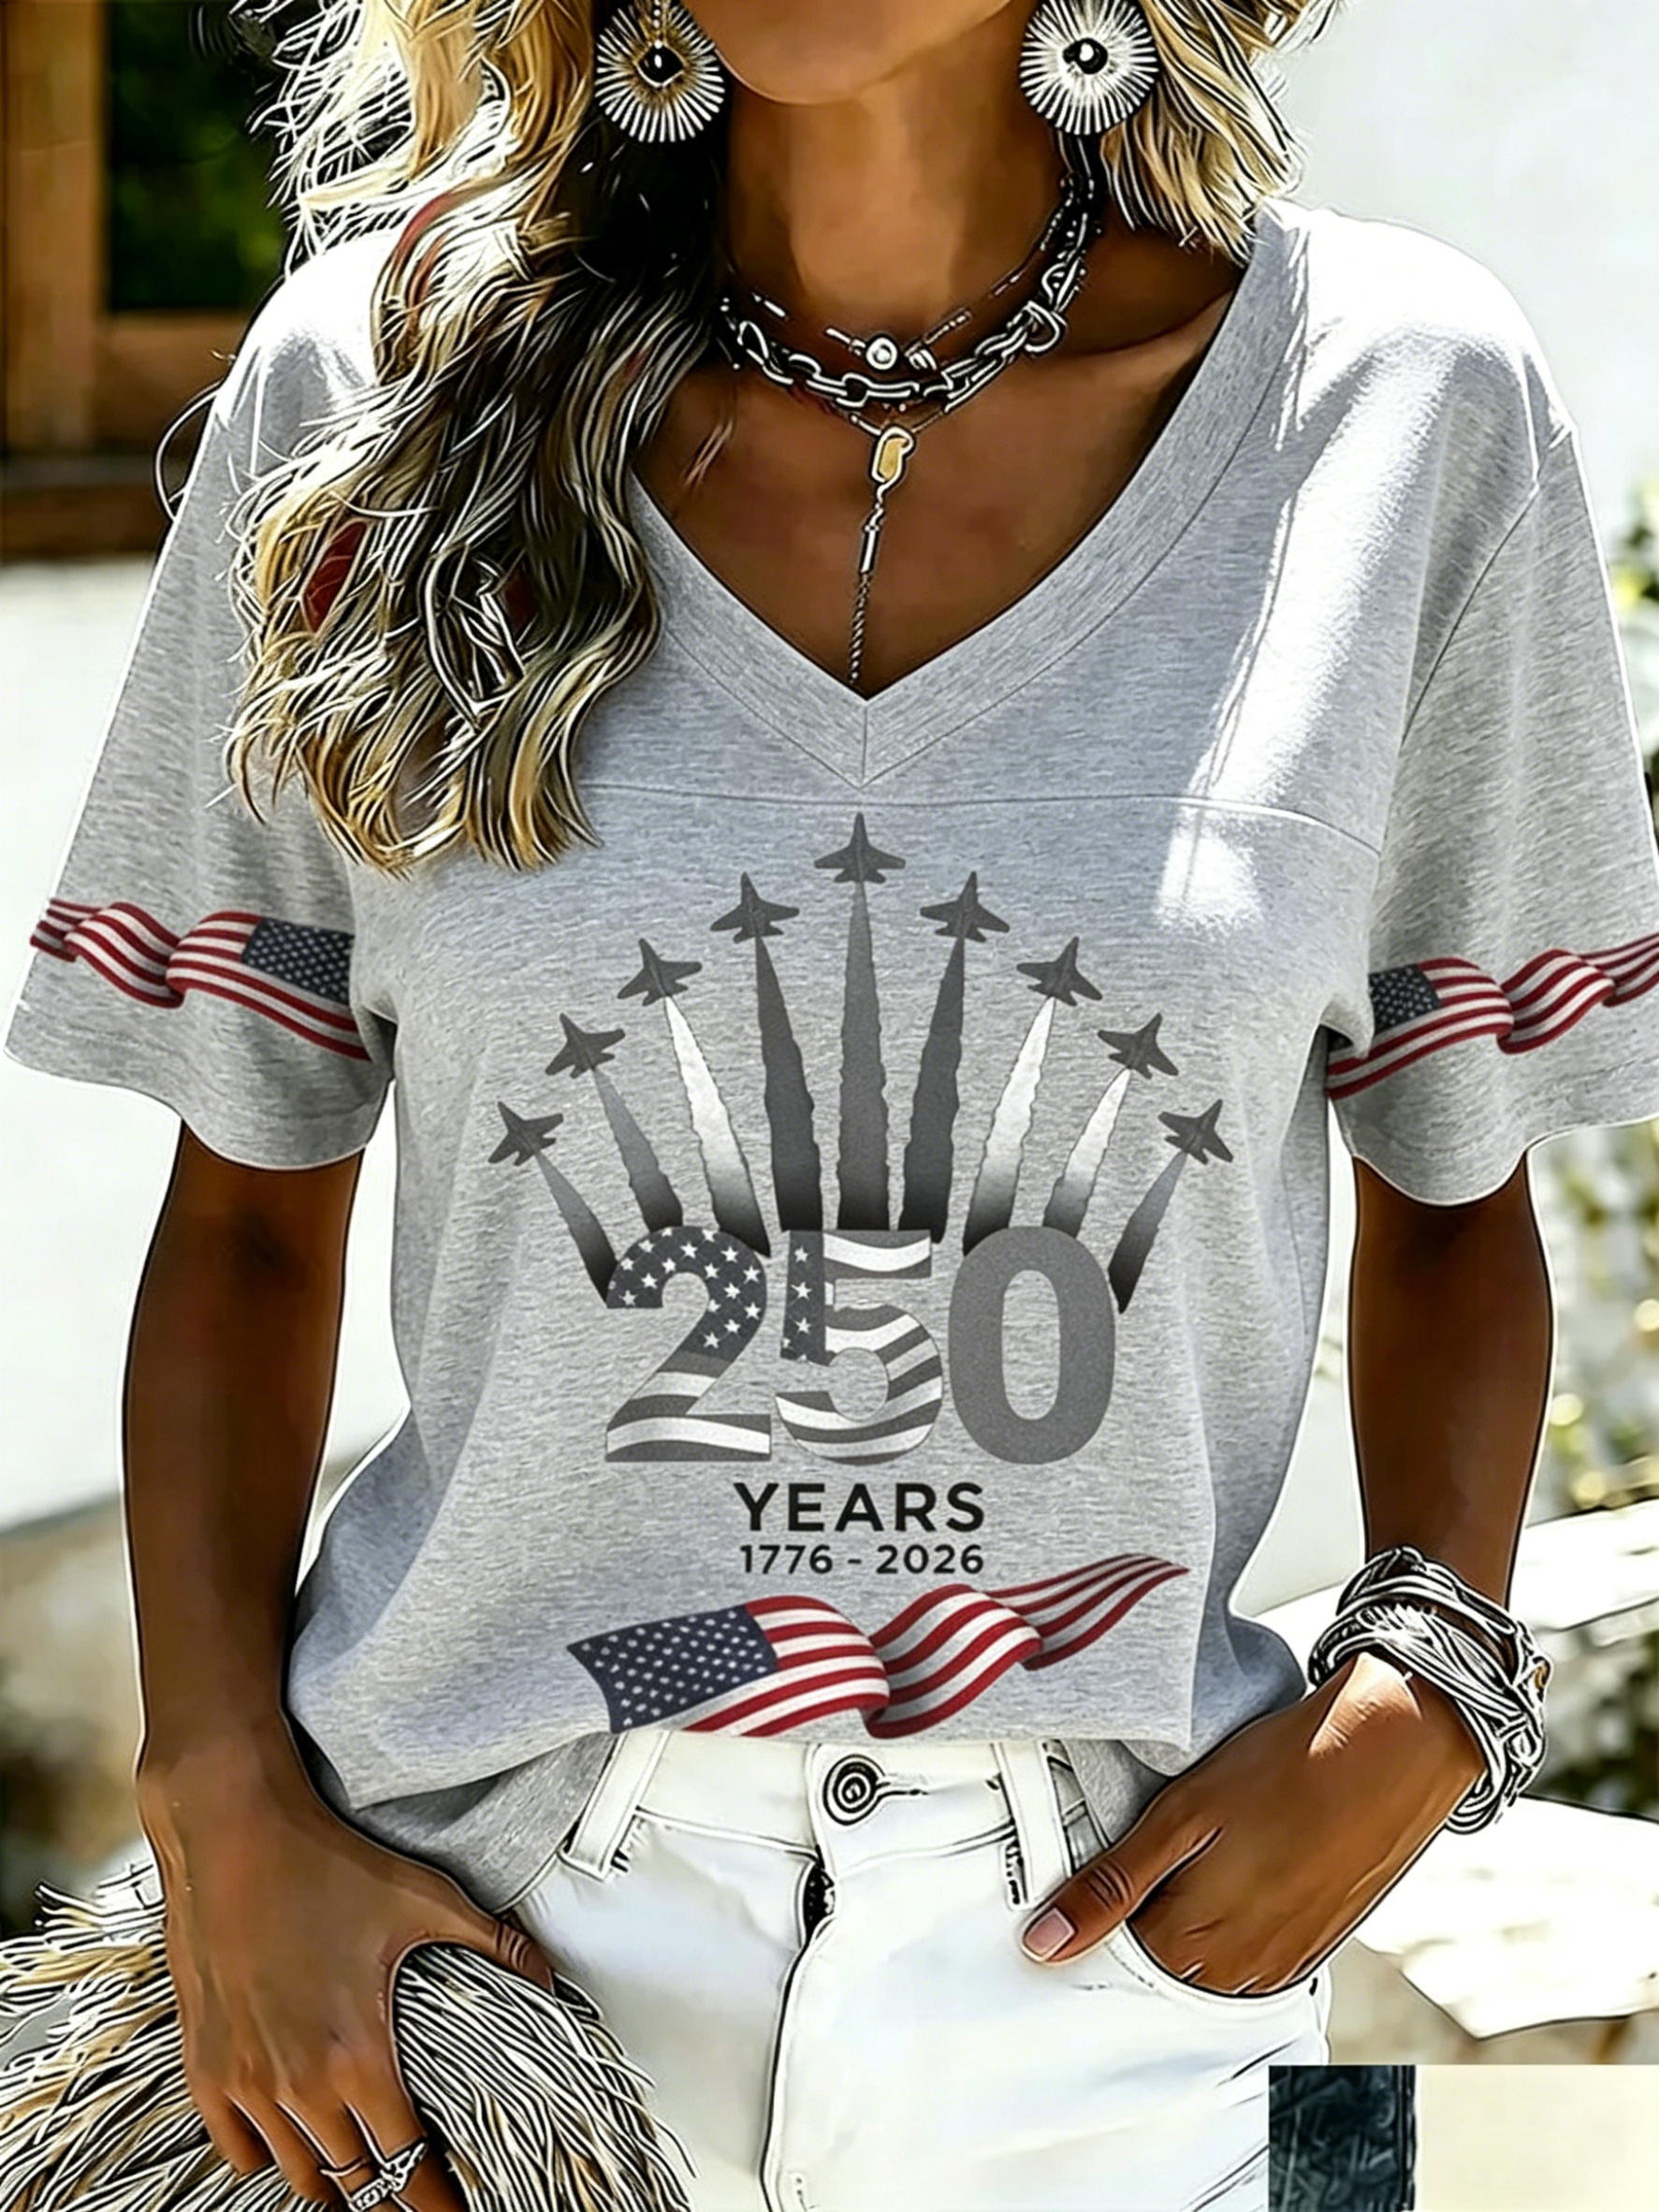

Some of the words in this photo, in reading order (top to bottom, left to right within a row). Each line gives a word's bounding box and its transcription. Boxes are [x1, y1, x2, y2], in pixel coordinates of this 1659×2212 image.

[604, 1226, 1116, 1465] 250
[733, 1481, 985, 1533] YEARS
[739, 1544, 834, 1575] 1776
[876, 1544, 984, 1575] 2026
